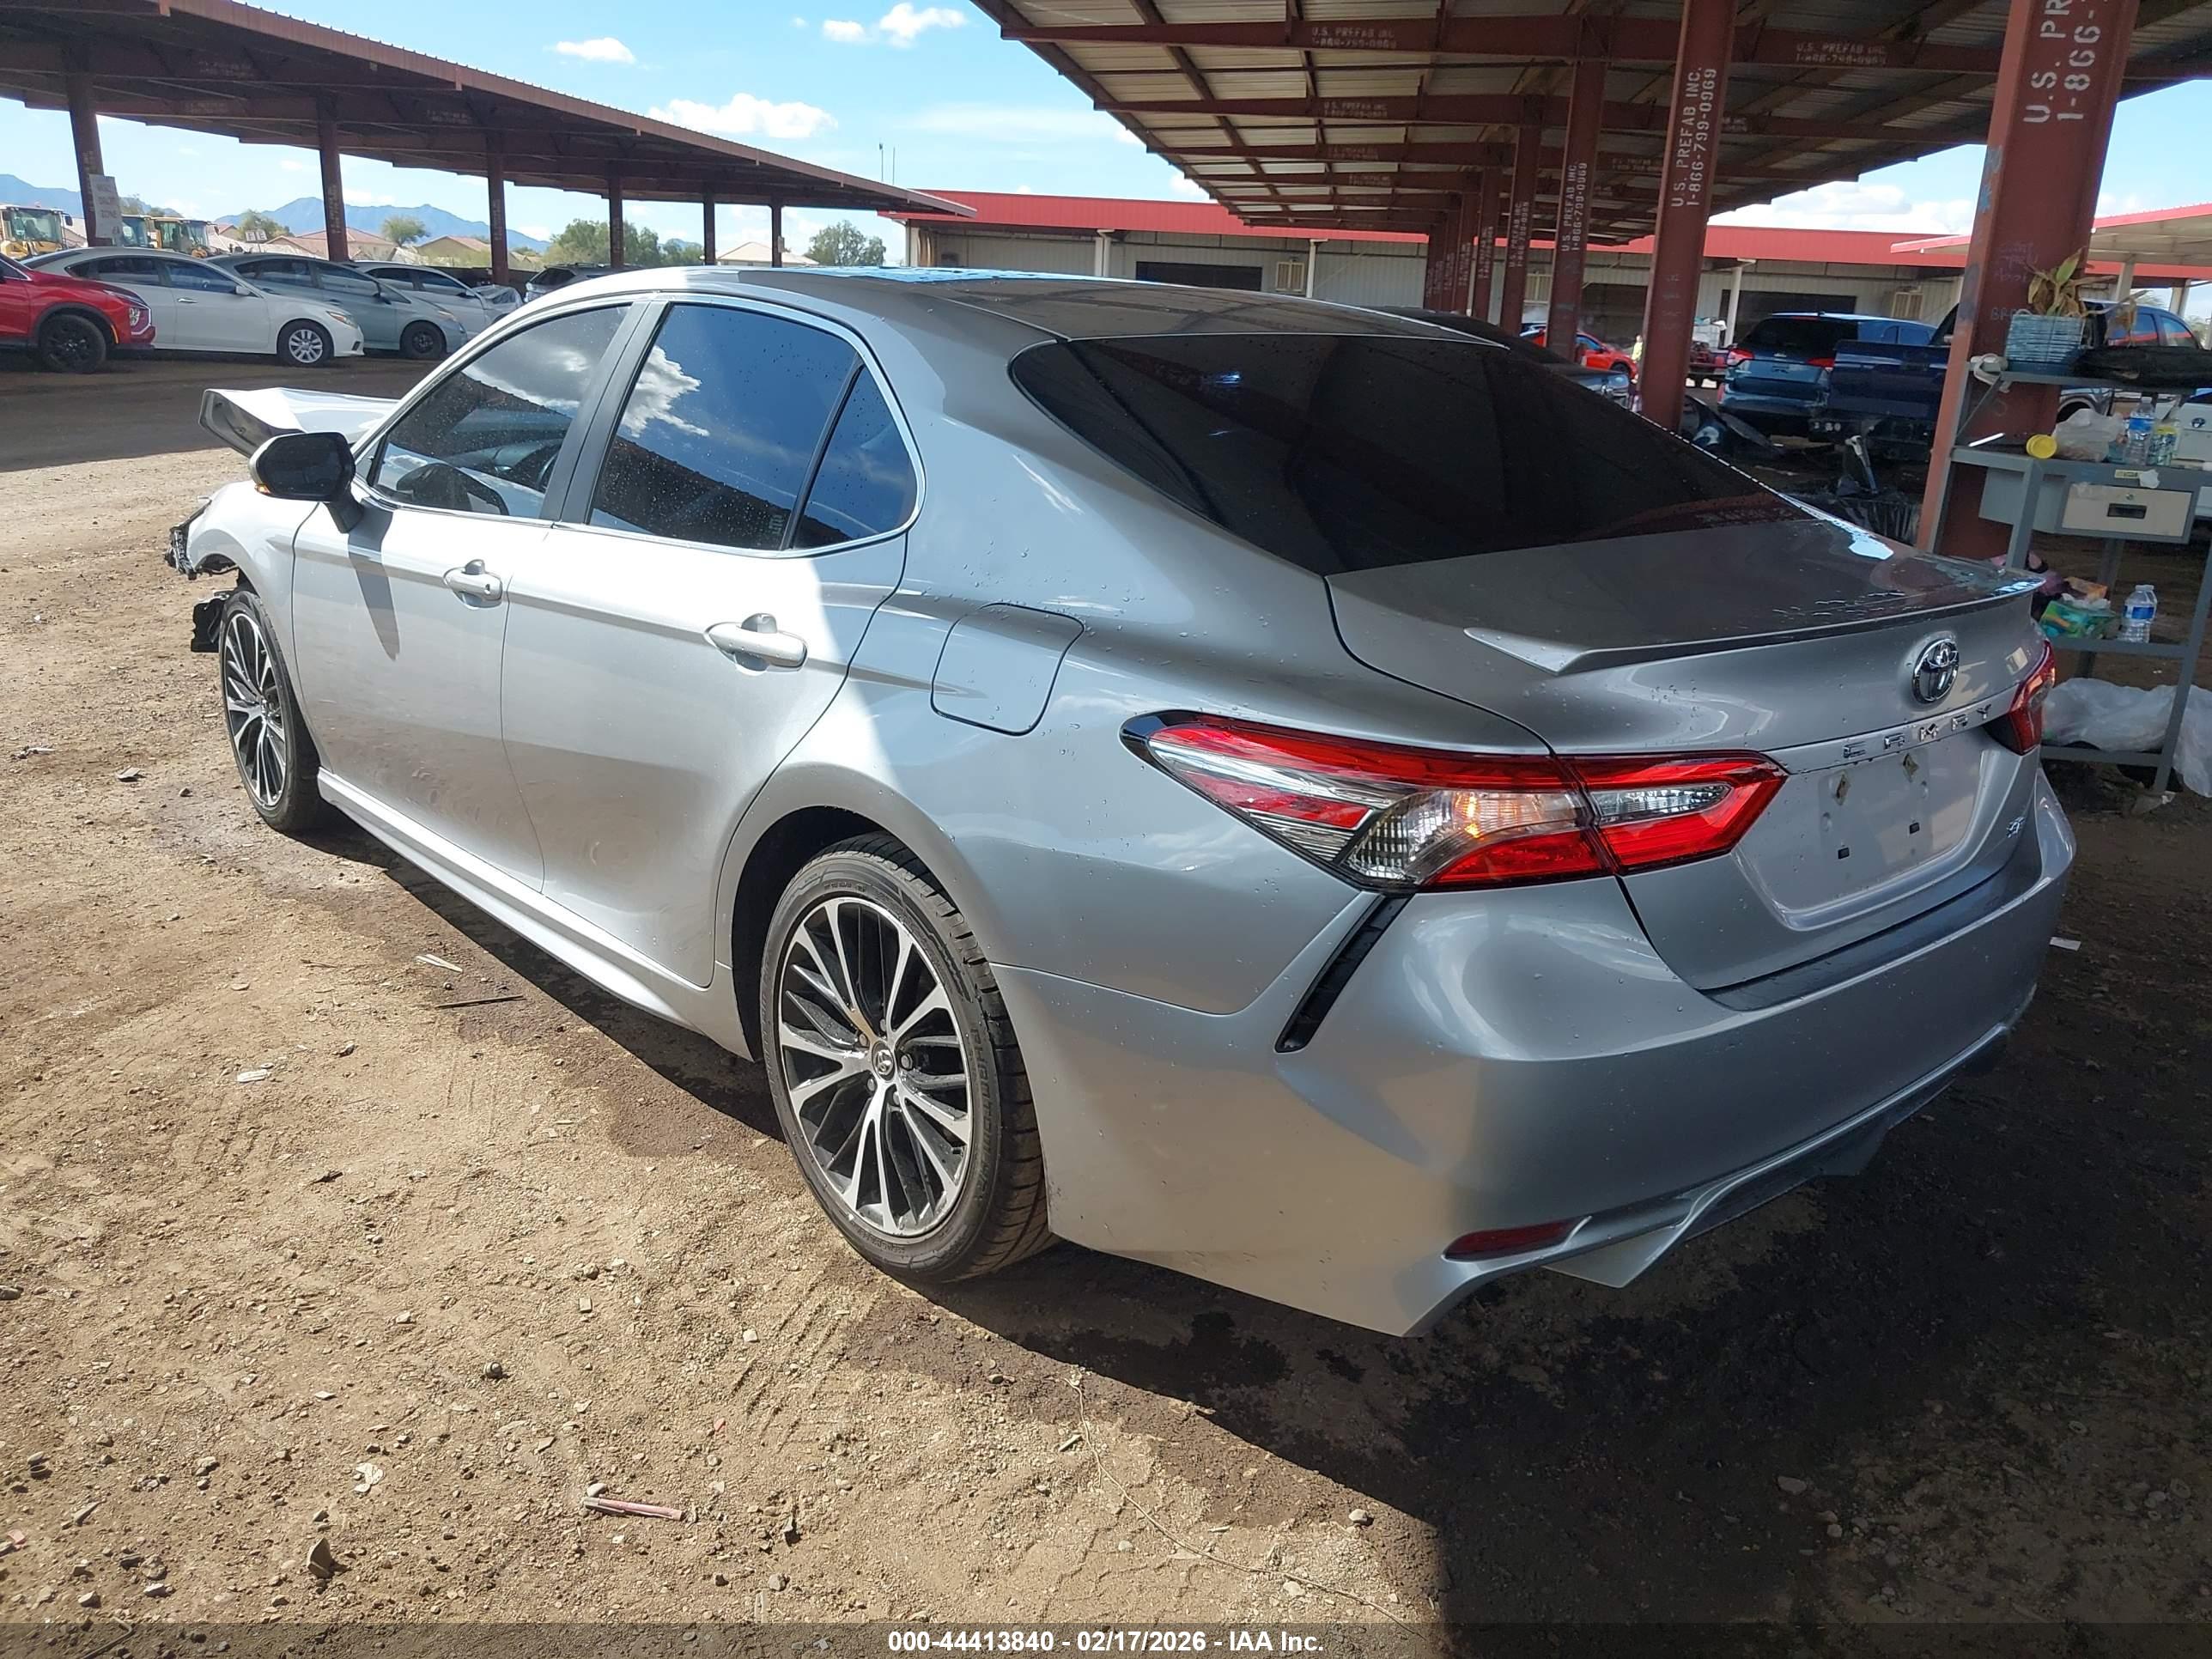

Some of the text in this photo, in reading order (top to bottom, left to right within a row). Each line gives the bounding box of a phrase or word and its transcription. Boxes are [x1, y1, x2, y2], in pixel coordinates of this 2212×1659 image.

[1686, 67, 1703, 98] INC.
[1676, 106, 1697, 168] PREFAB
[1686, 68, 1717, 206] 1-866-799-0969
[1564, 186, 1576, 227] PREFAB
